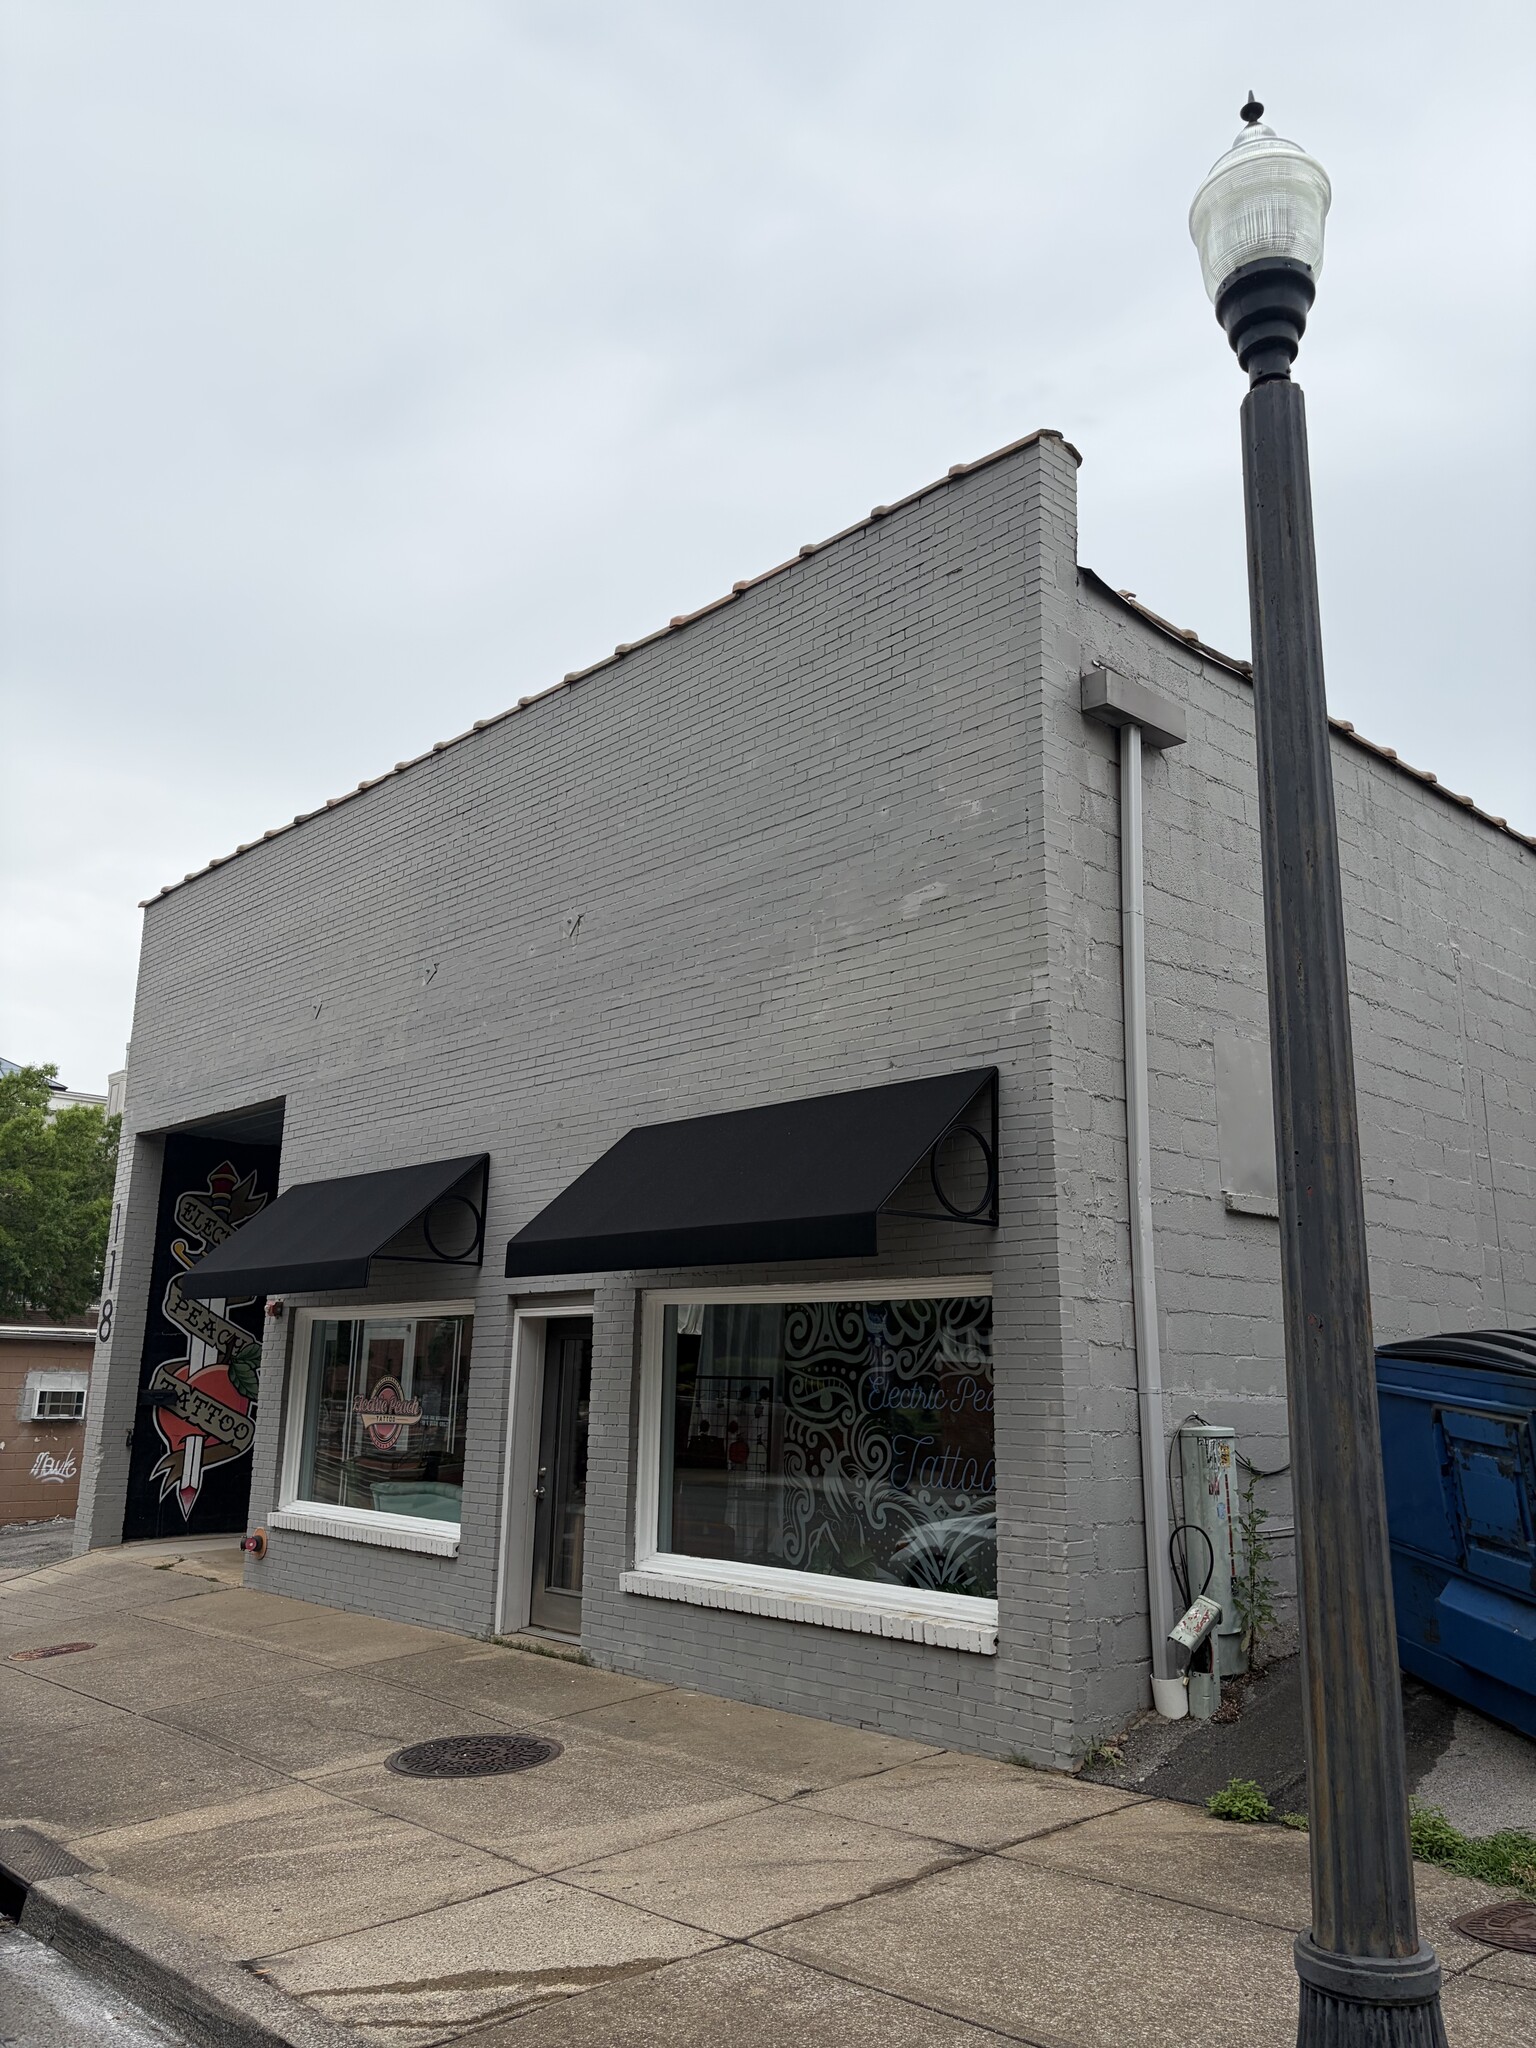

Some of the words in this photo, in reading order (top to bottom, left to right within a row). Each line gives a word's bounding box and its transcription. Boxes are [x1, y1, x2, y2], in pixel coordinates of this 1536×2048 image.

[180, 1201, 231, 1245] ELEC
[160, 1377, 250, 1441] TATTOO
[388, 1394, 420, 1415] Peach
[868, 1376, 948, 1411] Electric
[375, 1415, 397, 1423] TATTOO
[890, 1434, 996, 1493] Tattoo
